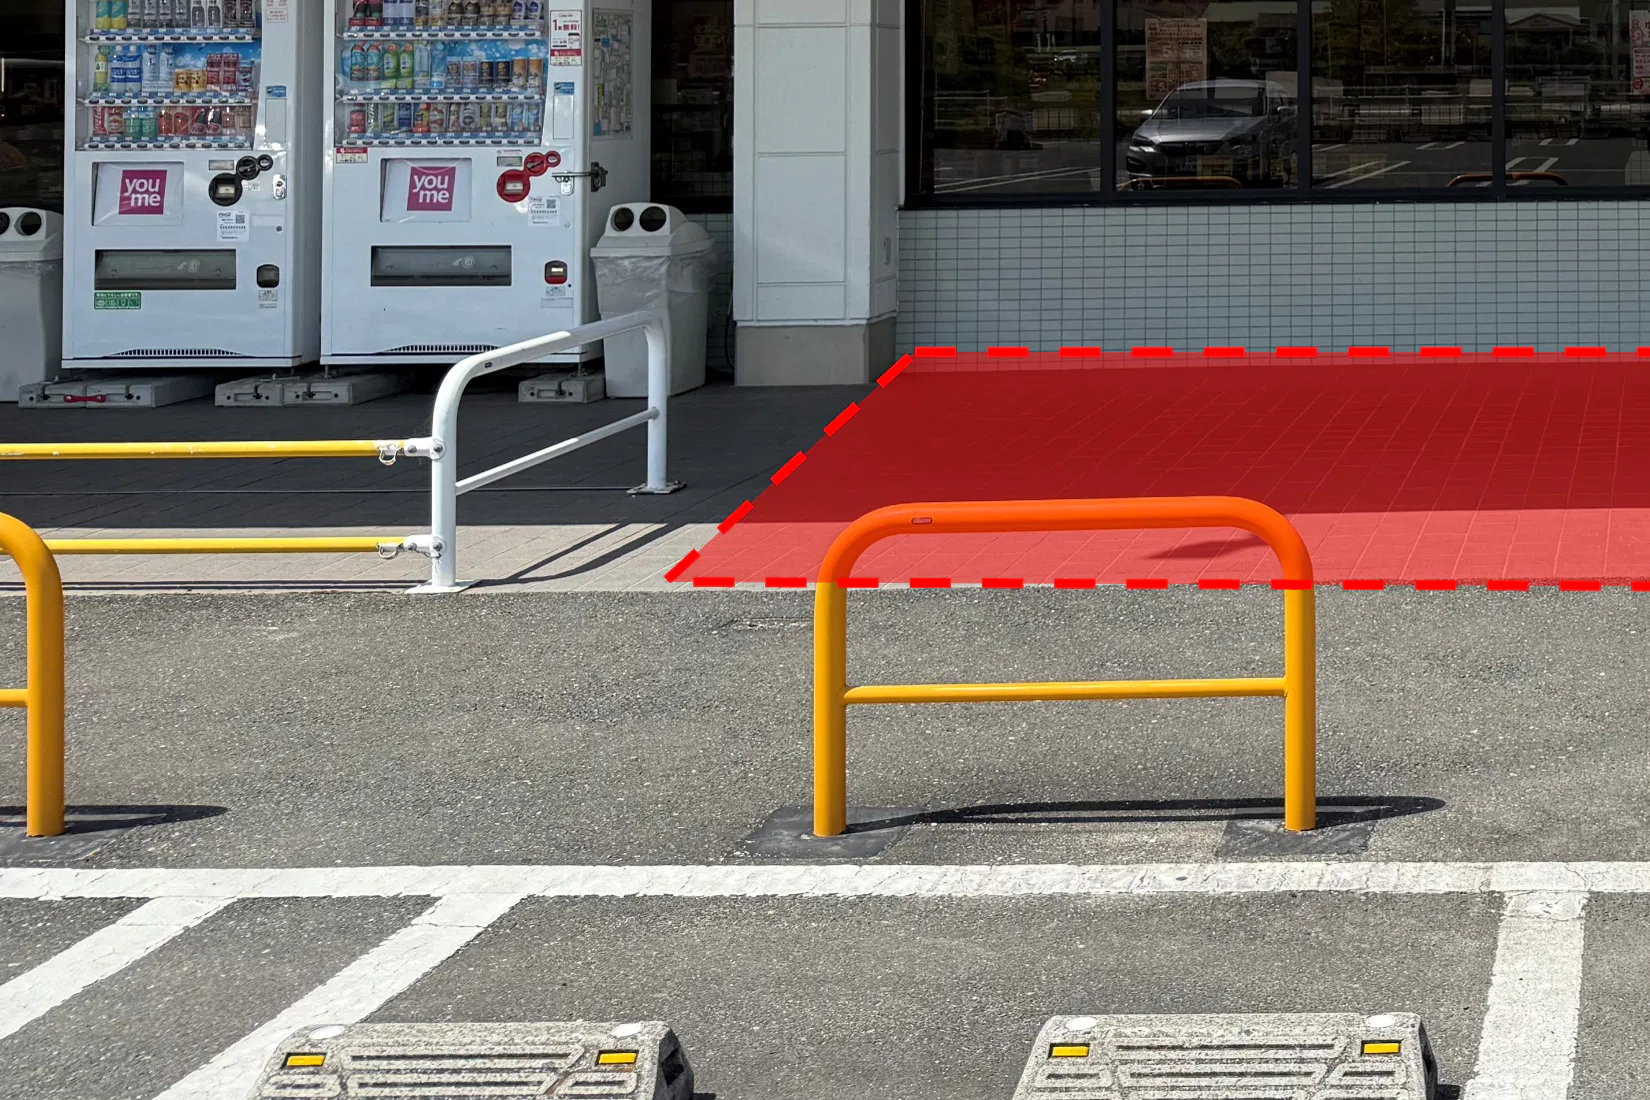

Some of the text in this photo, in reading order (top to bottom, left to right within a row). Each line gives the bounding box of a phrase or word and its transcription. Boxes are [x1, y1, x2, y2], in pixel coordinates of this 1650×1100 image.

[124, 178, 160, 196] you
[413, 175, 449, 192] you
[130, 192, 161, 207] me
[418, 189, 450, 204] me
